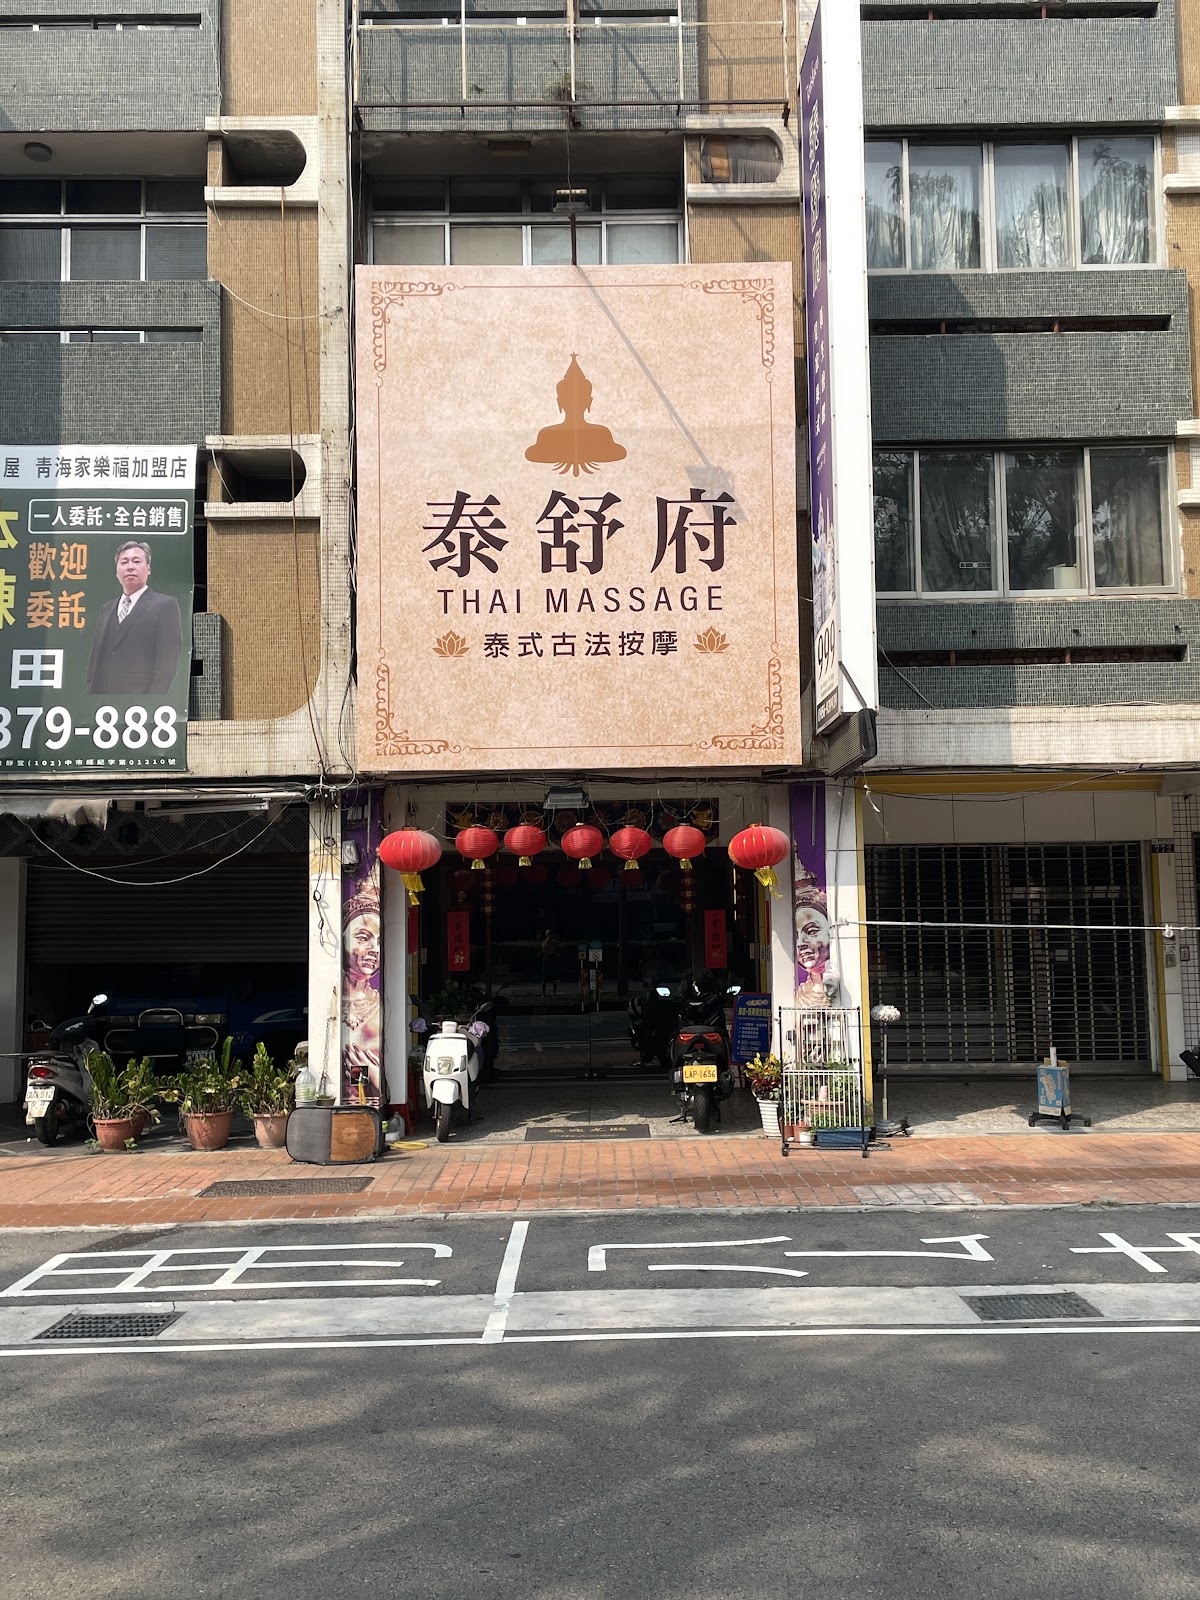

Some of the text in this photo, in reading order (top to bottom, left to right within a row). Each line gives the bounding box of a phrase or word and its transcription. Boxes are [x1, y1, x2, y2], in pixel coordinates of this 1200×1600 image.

[3, 456, 188, 479] 屋 青海家樂福加盟店
[421, 487, 738, 578] 泰舒府
[28, 541, 88, 581] 歡迎
[26, 590, 86, 629] 委託
[437, 585, 724, 614] THAI MASSAGE
[483, 630, 679, 658] 泰式古法按摩
